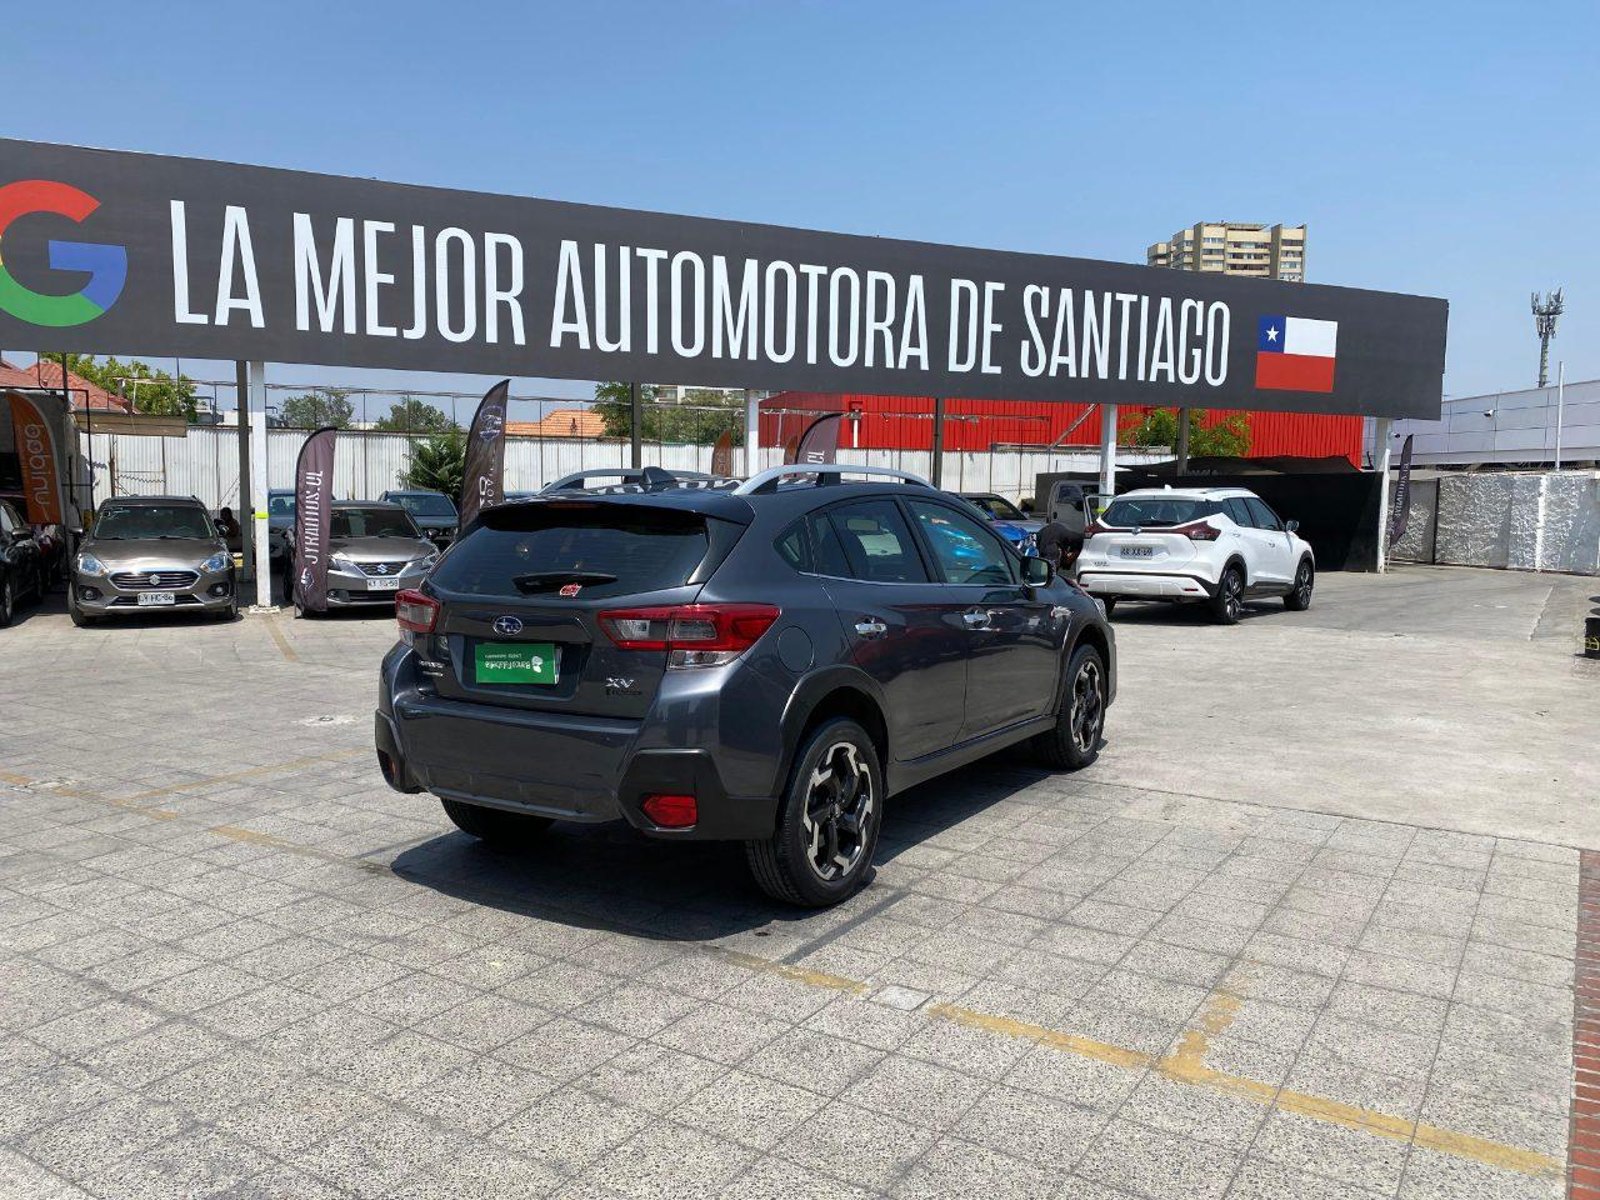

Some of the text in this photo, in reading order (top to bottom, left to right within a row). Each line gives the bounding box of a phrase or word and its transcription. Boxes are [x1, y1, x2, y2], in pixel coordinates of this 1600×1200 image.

[169, 199, 1231, 388] LA MEJOR AUTOMOTORA DE SANTIAGO
